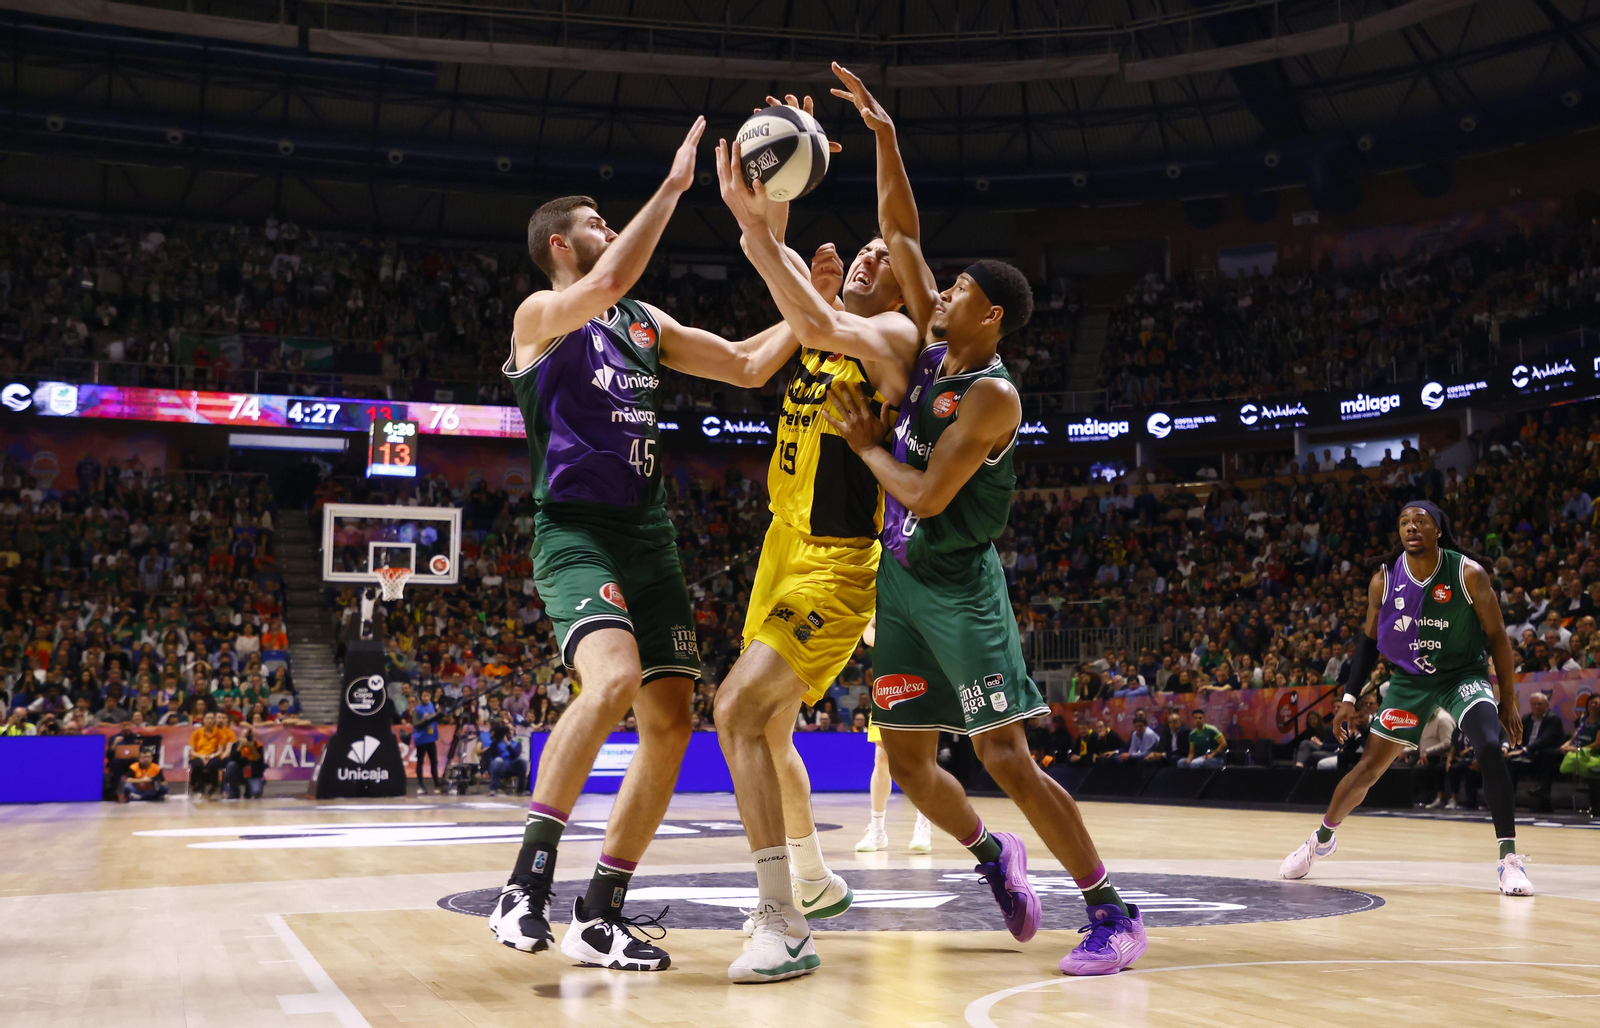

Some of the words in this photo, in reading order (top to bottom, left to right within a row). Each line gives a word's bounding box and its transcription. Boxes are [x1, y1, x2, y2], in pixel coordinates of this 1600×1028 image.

[228, 396, 261, 421] 74
[288, 402, 341, 424] 4:27
[429, 405, 460, 430] 76
[379, 443, 411, 467] 13
[628, 438, 656, 477] 45
[780, 440, 798, 476] 19
[875, 677, 925, 700] famadesa
[337, 767, 389, 783] Unicaja
